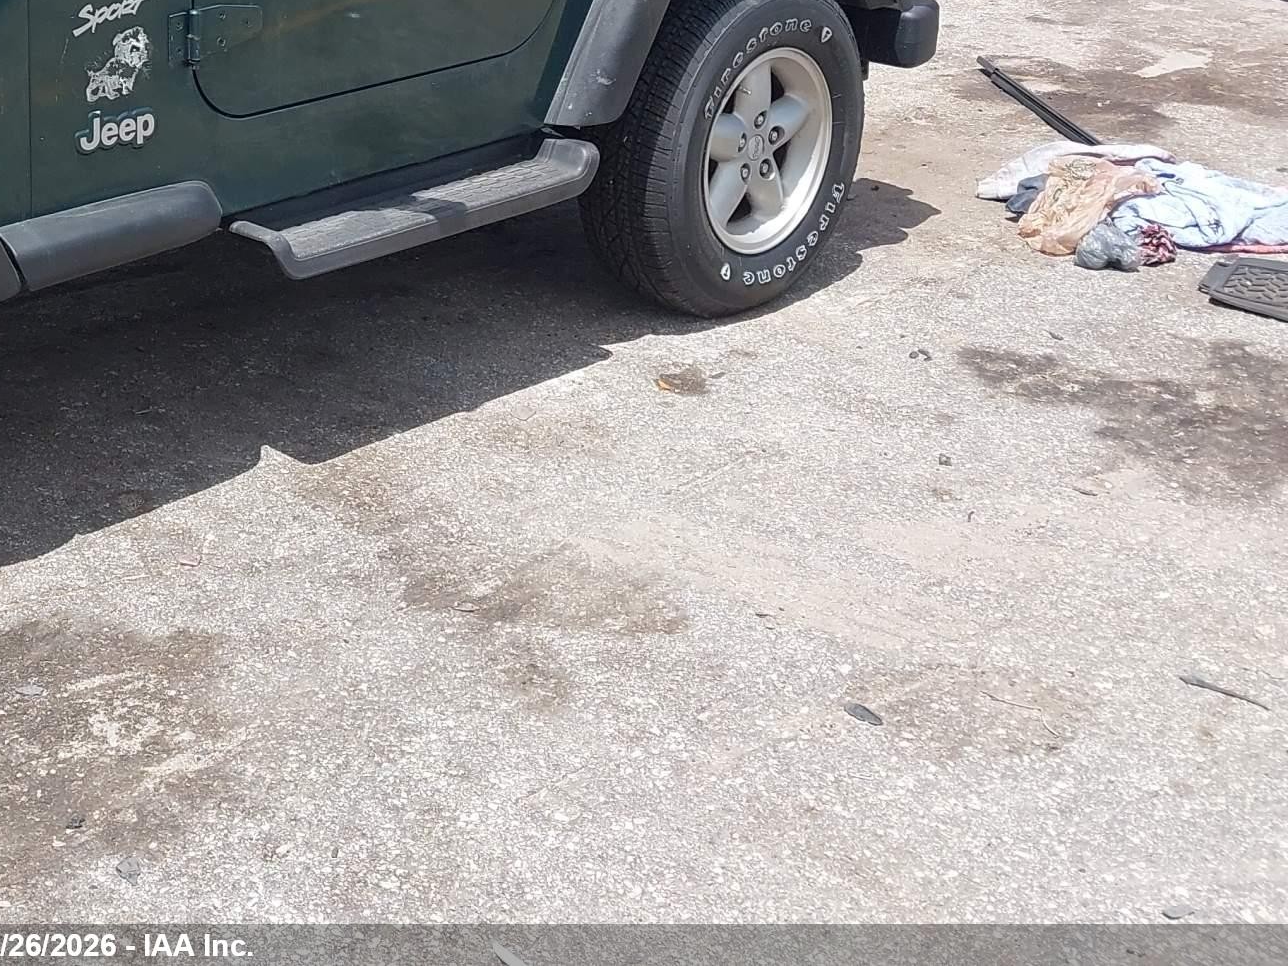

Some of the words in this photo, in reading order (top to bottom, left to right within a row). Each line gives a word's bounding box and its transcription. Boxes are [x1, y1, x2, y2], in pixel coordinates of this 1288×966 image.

[703, 17, 813, 122] Firestone
[78, 110, 155, 151] Jeep
[742, 182, 846, 286] Firestone
